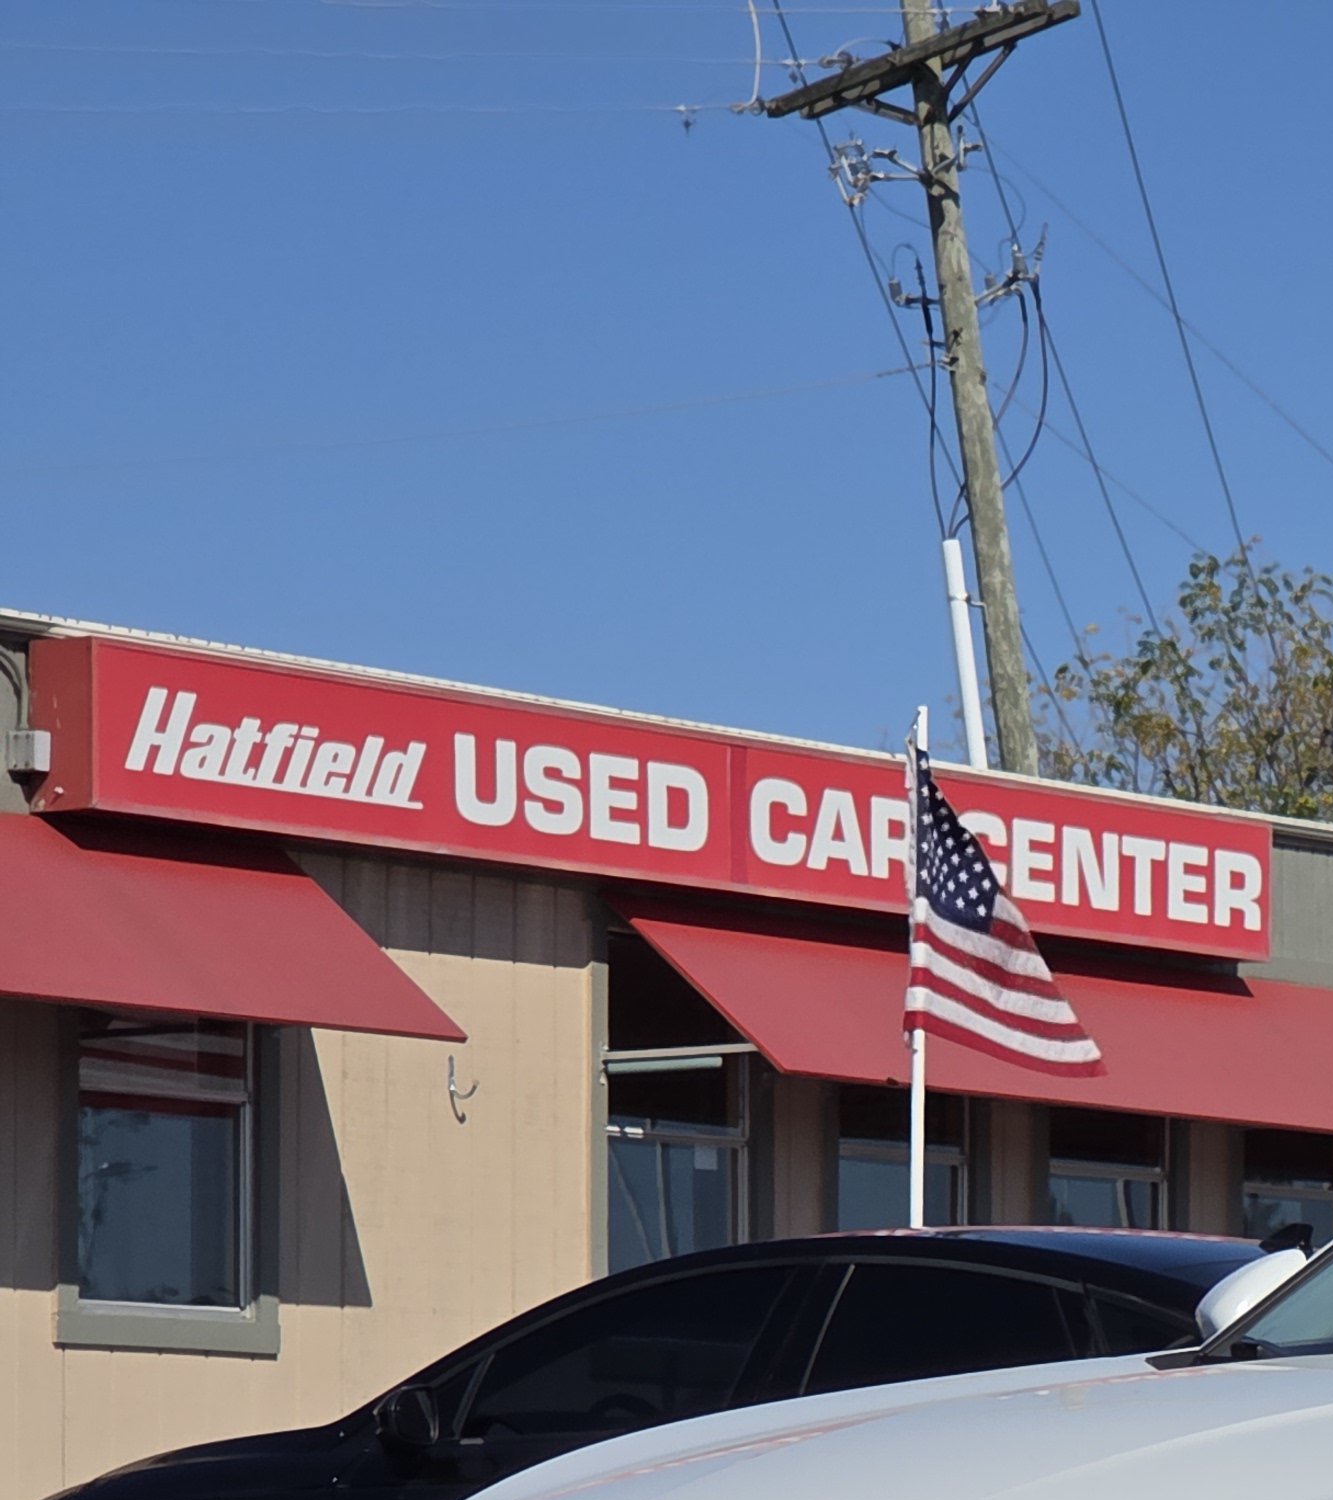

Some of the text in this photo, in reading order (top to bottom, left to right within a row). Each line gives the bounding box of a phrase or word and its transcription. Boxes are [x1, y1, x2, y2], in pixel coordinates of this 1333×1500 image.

[125, 686, 427, 811] Hatfield
[454, 732, 709, 852] USED
[750, 777, 911, 880] CAR
